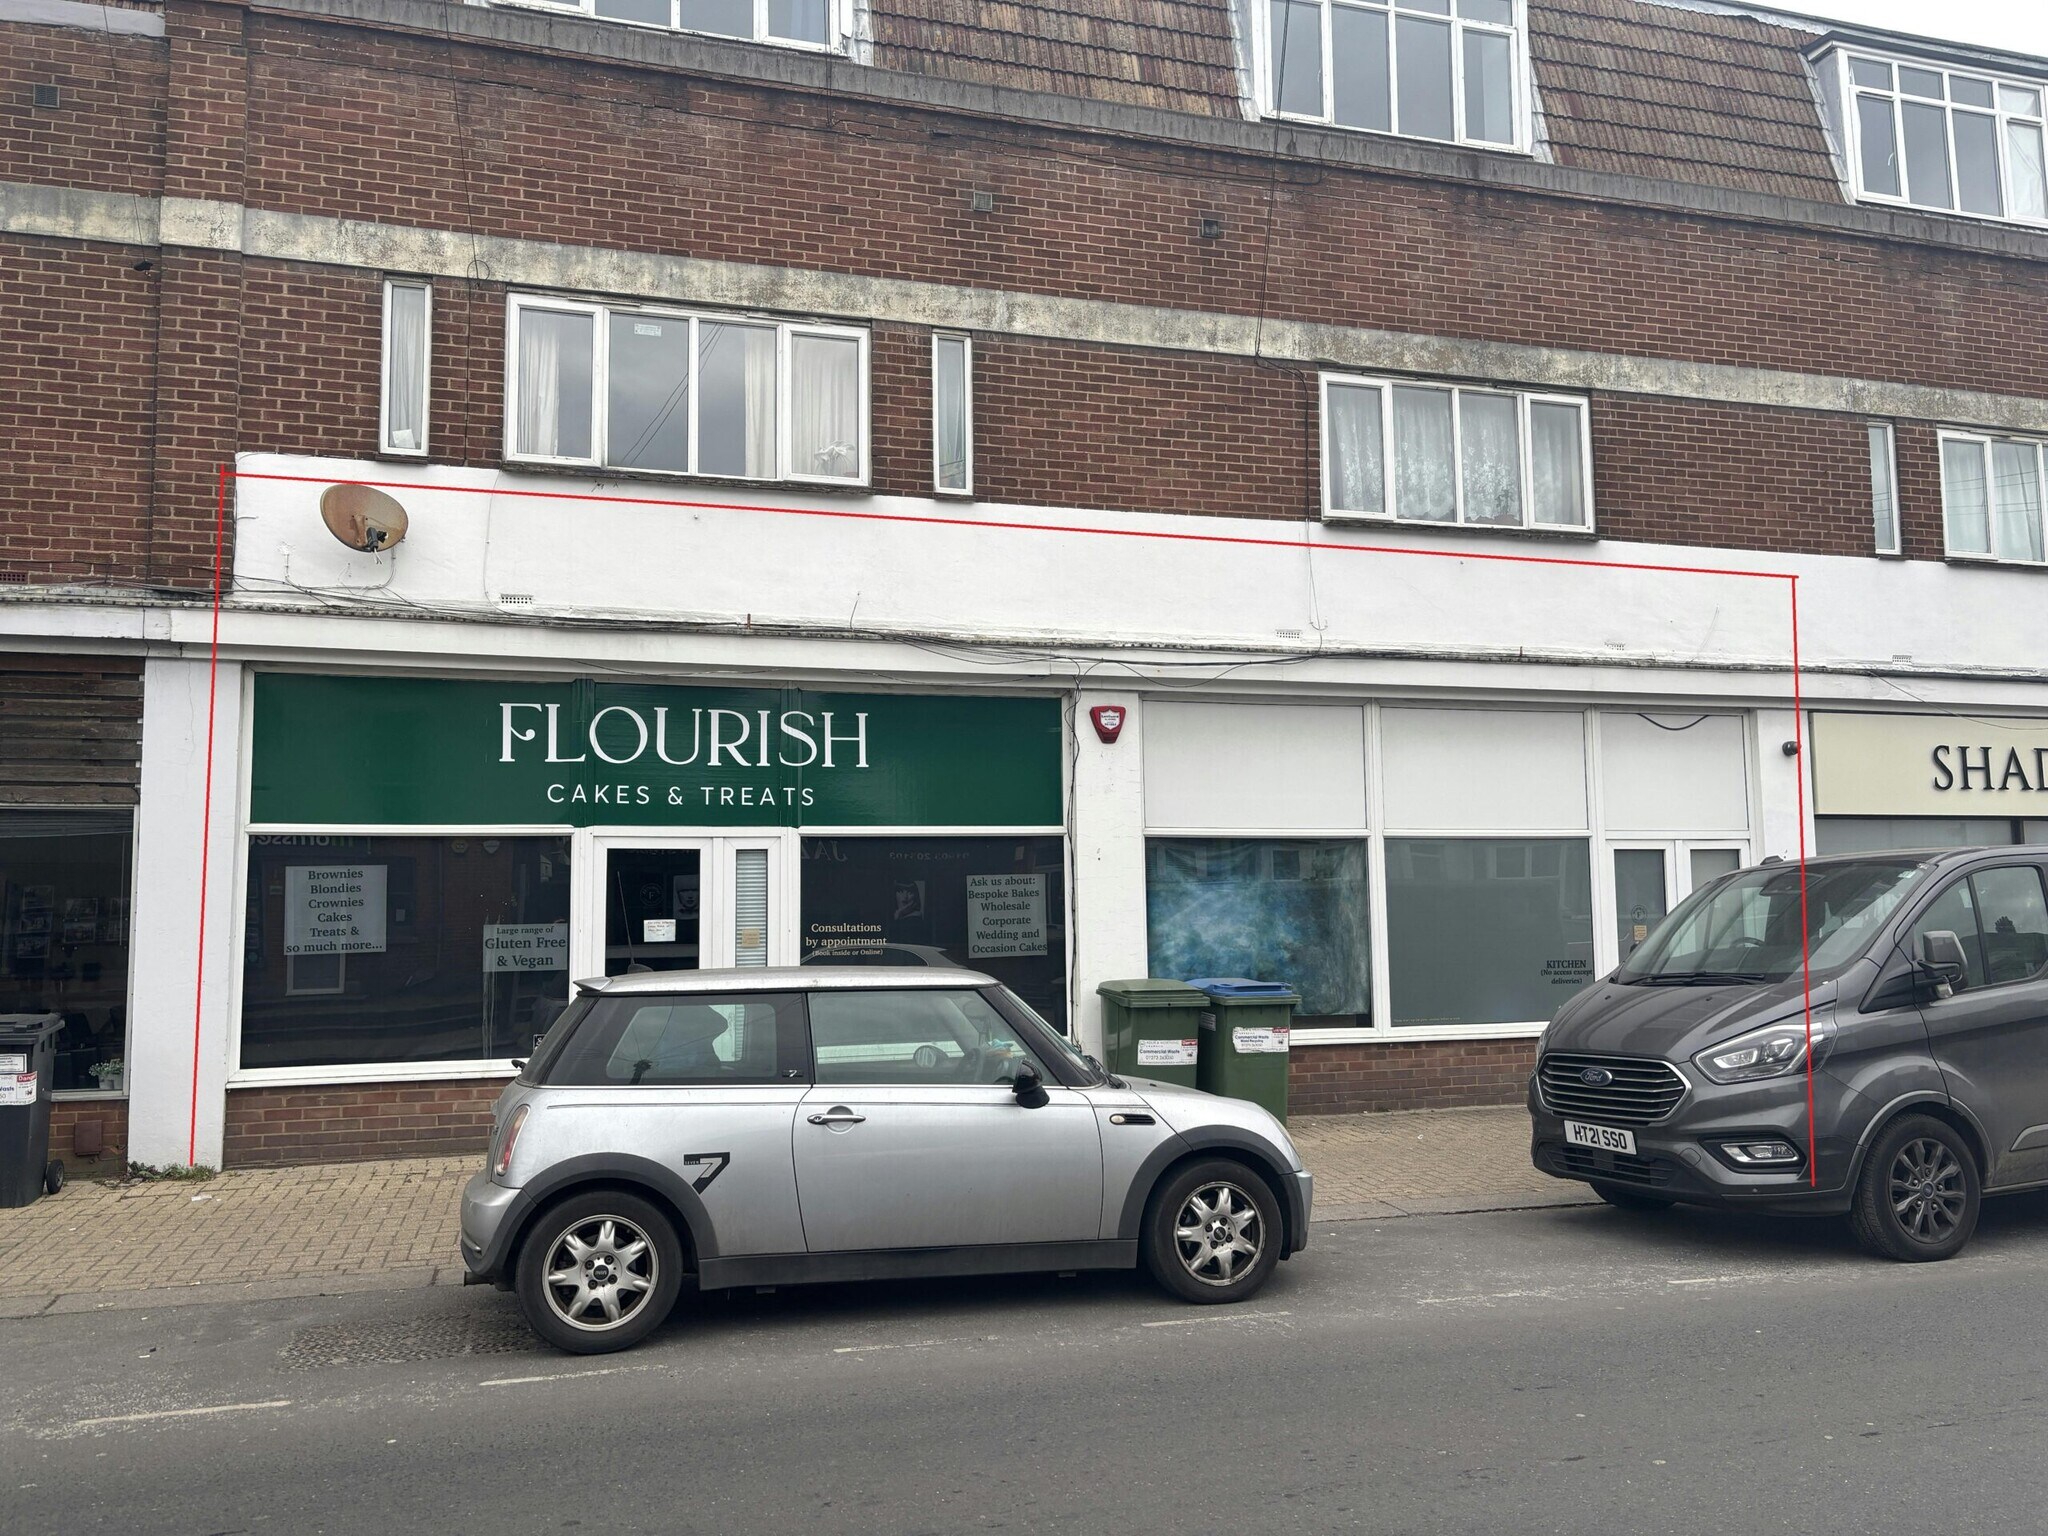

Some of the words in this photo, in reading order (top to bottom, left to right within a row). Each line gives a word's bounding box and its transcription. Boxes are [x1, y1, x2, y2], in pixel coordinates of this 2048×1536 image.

[499, 702, 869, 768] FLOURISH
[547, 784, 650, 805] CAKES
[667, 786, 683, 805] &
[700, 786, 814, 806] TREATS
[308, 869, 364, 880] Brownies
[970, 876, 988, 886] Ask
[991, 878, 1002, 886] us
[1005, 876, 1036, 885] about:
[310, 883, 362, 894] Blondies
[968, 889, 1009, 900] Bespoke
[1011, 888, 1040, 898] Bakes
[308, 898, 364, 909] Crownies
[981, 901, 1031, 911] Wholesale
[317, 912, 352, 922] Cakes
[982, 917, 1031, 927] Corporate
[310, 927, 347, 937] Treats
[350, 926, 360, 936] &
[496, 927, 519, 935] Large
[545, 926, 554, 934] of
[811, 923, 882, 932] Consultations
[976, 930, 1018, 940] Wedding
[1021, 929, 1040, 938] and
[286, 944, 300, 953] so
[304, 941, 337, 952] much
[341, 942, 383, 951] more...
[485, 937, 532, 949] Gluten
[536, 937, 566, 948] Free
[805, 937, 818, 948] by
[821, 936, 887, 948] appointment
[972, 944, 1016, 953] Occasion
[1019, 942, 1048, 952] Cakes
[497, 955, 508, 967] &
[512, 955, 554, 969] Vegan
[1546, 960, 1587, 969] KITCHEN
[1551, 977, 1583, 985] deliveries)
[1584, 1070, 1603, 1082] Ford
[1573, 1123, 1600, 1146] HT21
[1601, 1129, 1627, 1150] SSO
